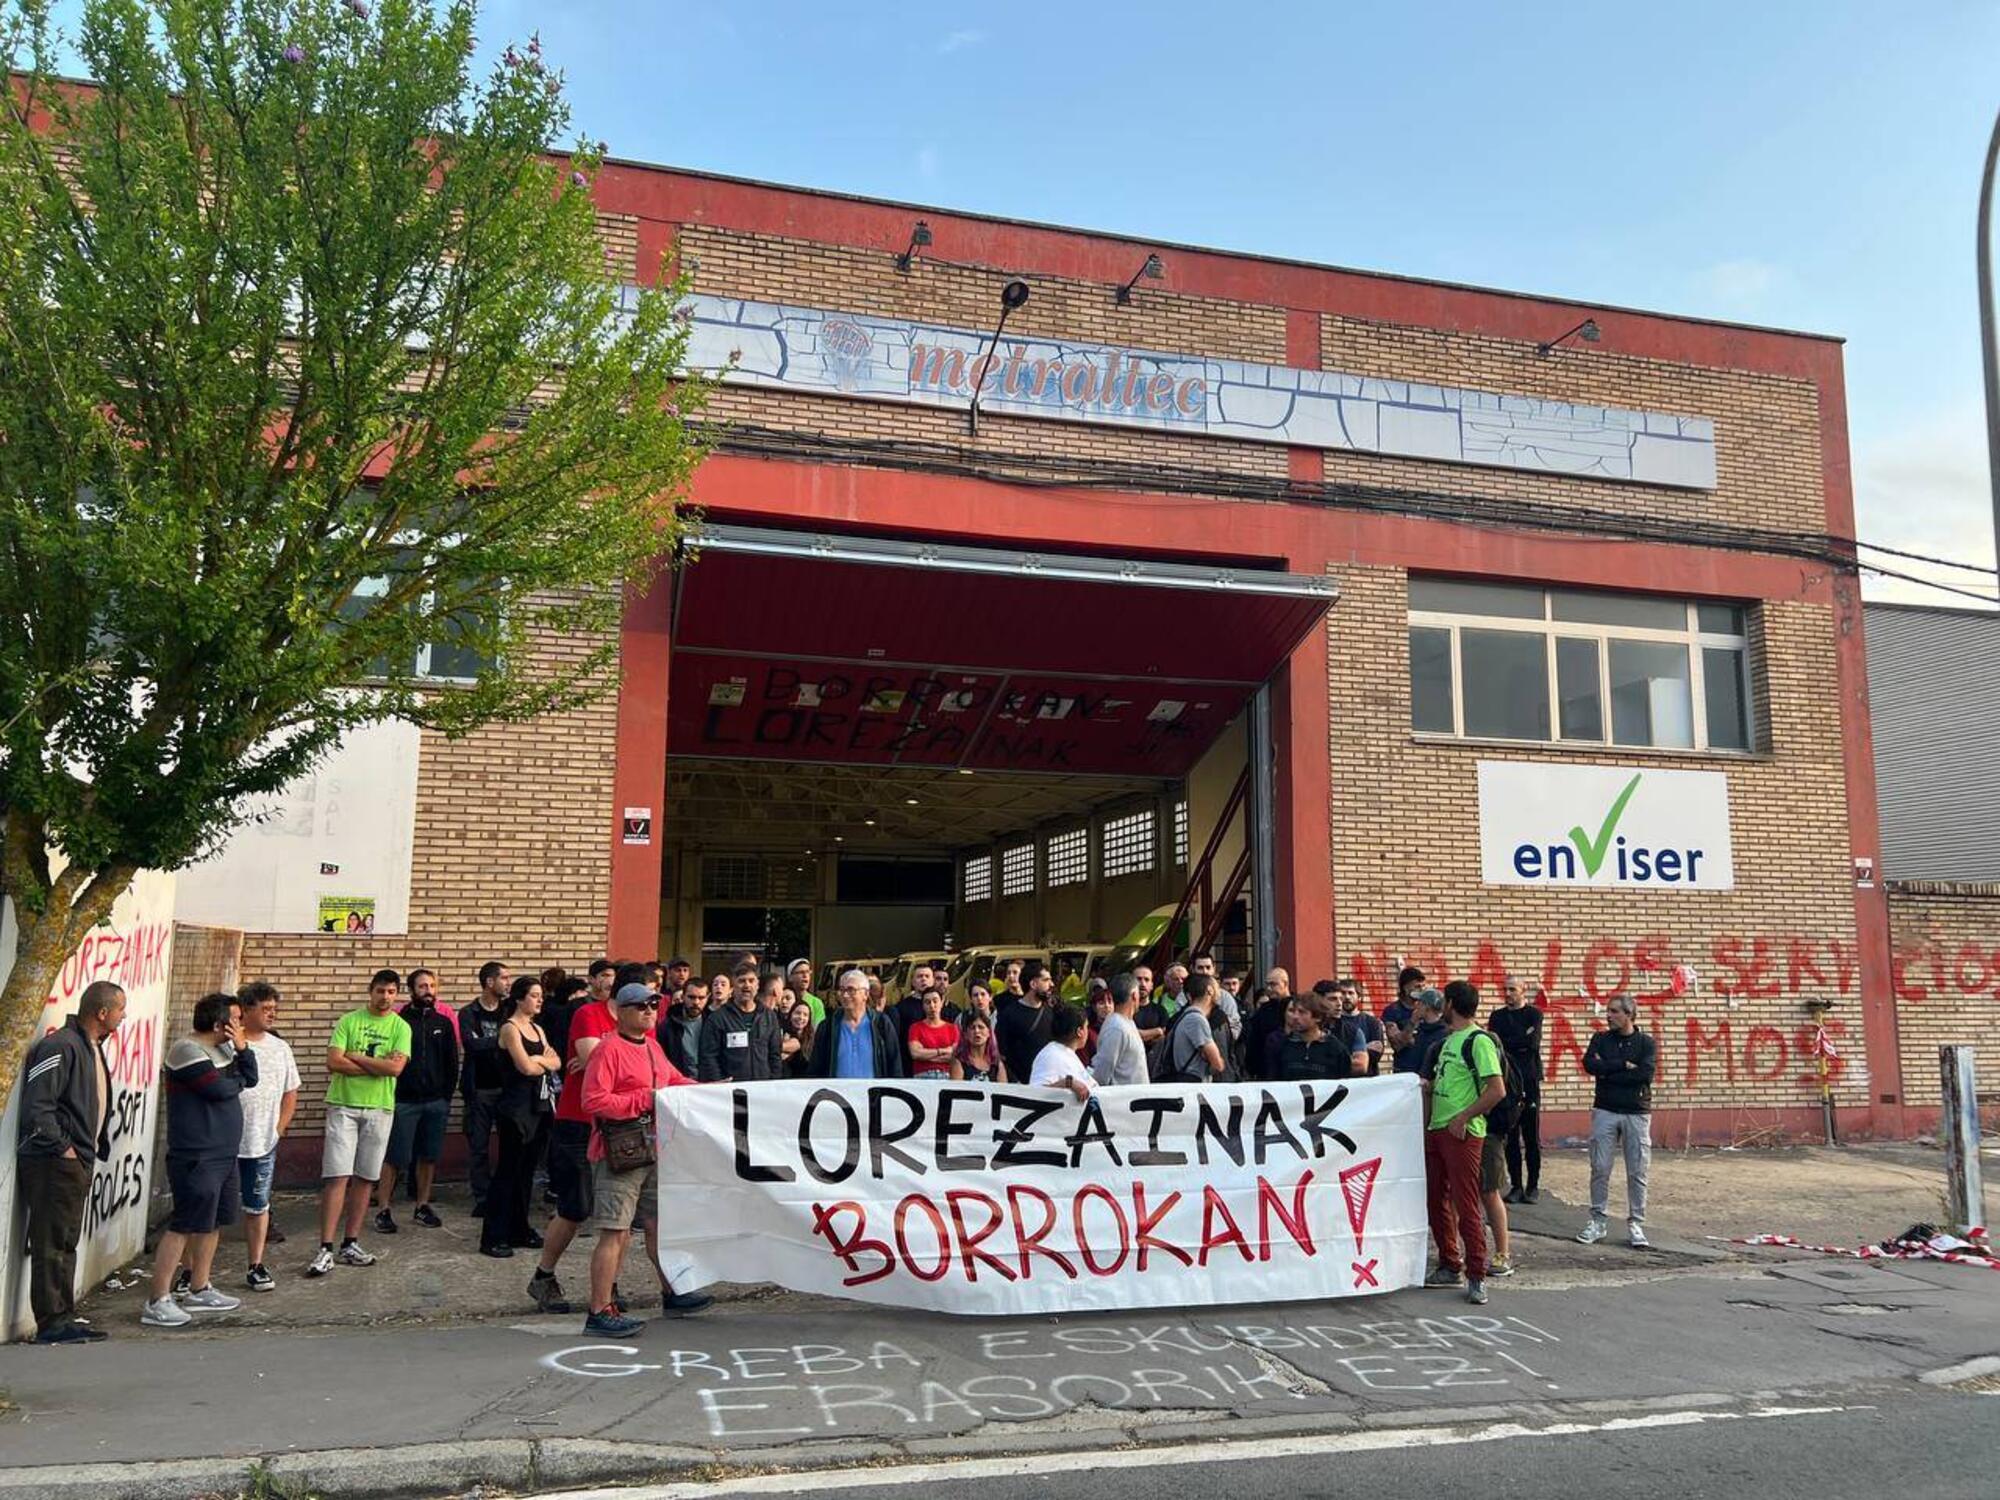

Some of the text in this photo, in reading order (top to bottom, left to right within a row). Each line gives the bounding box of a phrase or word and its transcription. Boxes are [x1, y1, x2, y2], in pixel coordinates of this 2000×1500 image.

[911, 342, 1207, 414] metraltec
[47, 913, 168, 1003] OREZAINAK
[732, 1082, 1357, 1183] LOREZAINAK
[539, 1341, 921, 1380] GREBA
